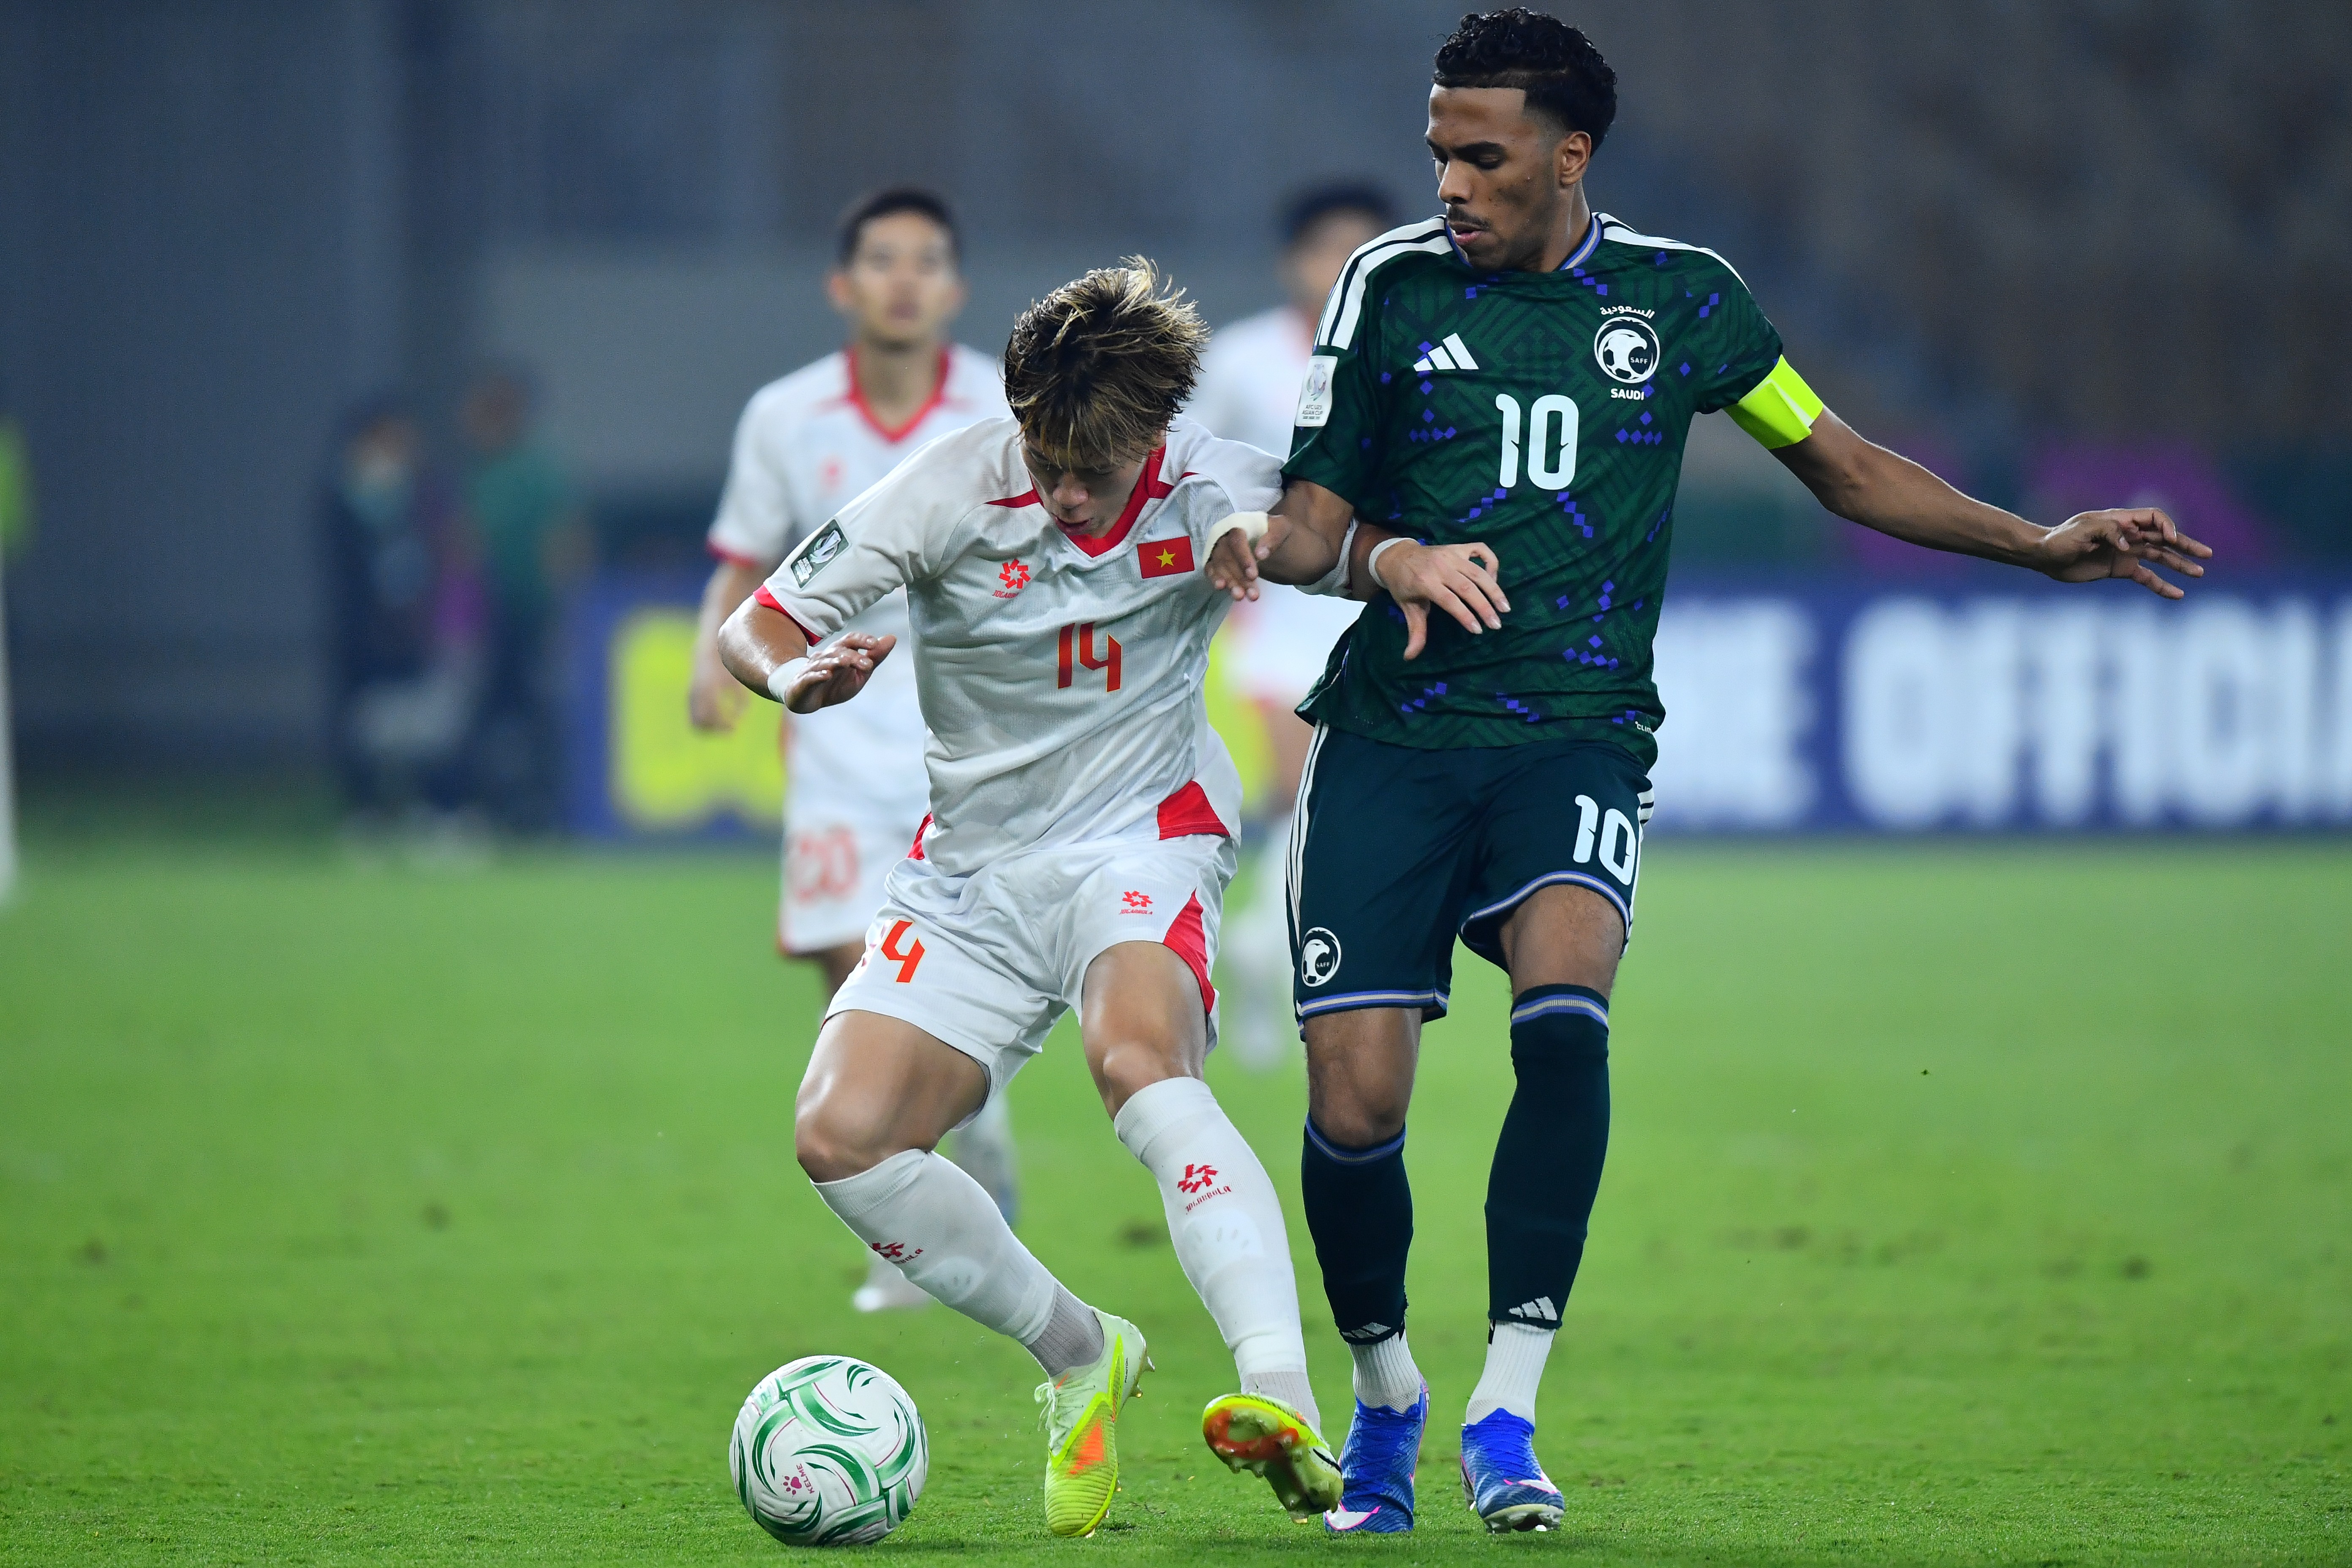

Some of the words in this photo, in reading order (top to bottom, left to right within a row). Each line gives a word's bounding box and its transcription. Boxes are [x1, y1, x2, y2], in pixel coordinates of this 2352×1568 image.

[1600, 305, 1655, 319] السعودية
[1610, 388, 1644, 400] SAUDI
[1495, 393, 1579, 490] 10
[1057, 621, 1122, 693] 14
[1844, 600, 2352, 823] OFFICI
[1573, 795, 1636, 885] 10
[880, 919, 926, 984] 4
[796, 1463, 815, 1494] KELME
